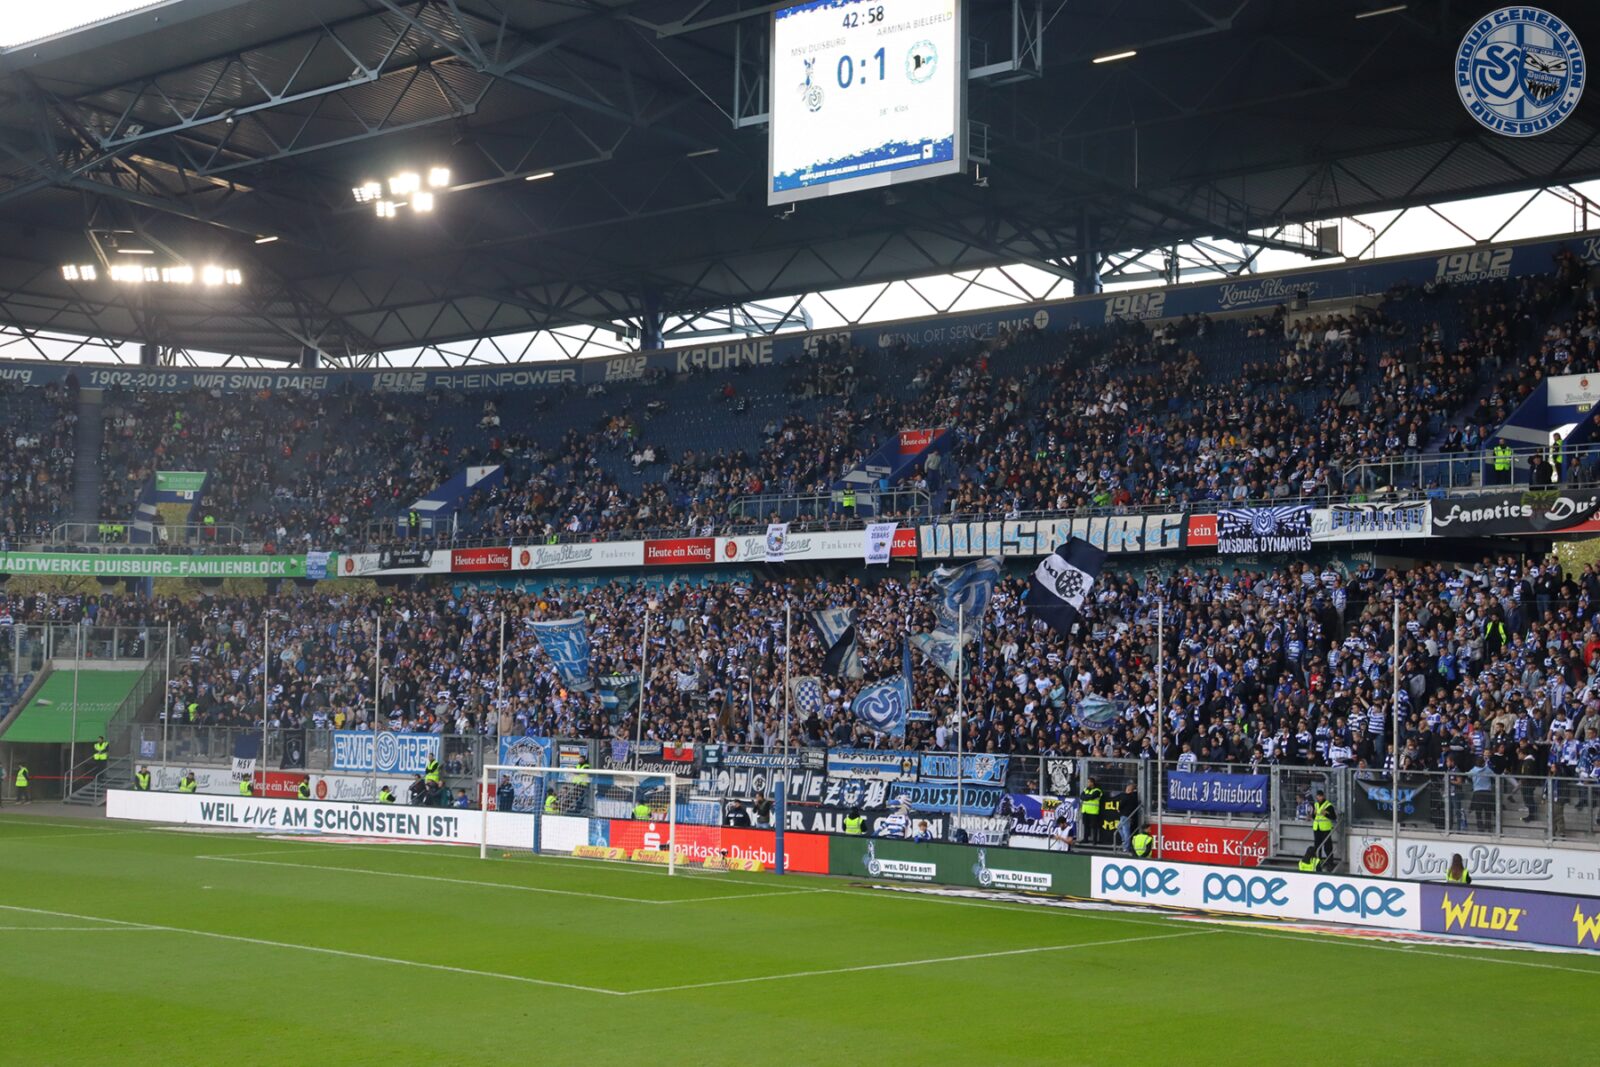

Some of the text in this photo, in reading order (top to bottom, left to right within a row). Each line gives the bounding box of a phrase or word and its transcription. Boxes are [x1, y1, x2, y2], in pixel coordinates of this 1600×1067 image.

[877, 12, 953, 36] ARMINIA BIELEFELD
[791, 37, 847, 57] MSV DUISBURG
[837, 47, 886, 89] 0:1
[1435, 248, 1514, 277] 1902
[1480, 268, 1510, 279] DABEI
[1105, 292, 1166, 316] 1902
[1218, 284, 1261, 304] König
[606, 356, 648, 375] 1902
[677, 340, 773, 372] KROHNE
[0, 368, 33, 383] urg
[90, 370, 178, 388] 1902-2013
[193, 374, 226, 389] WIR
[233, 375, 272, 389] SIND
[372, 372, 428, 390] 1902
[435, 368, 577, 389] RHEINPOWER
[536, 548, 561, 564] König
[560, 544, 593, 561] Pilsener
[648, 543, 712, 561] Heute ein König
[821, 540, 863, 551] Fankurve
[1217, 535, 1312, 554] DUISBURG DYNAMITES
[94, 558, 286, 574] DUISBURG-FAMILIENBLOCK
[455, 555, 478, 567] Heute
[478, 555, 488, 565] ein
[488, 552, 510, 569] König
[333, 734, 375, 769] EWIG
[237, 759, 251, 769] MSV
[637, 759, 692, 776] Generation
[272, 781, 282, 790] ein
[333, 779, 361, 800] König
[1170, 778, 1198, 801] Block
[1212, 782, 1264, 808] Duisburg
[201, 802, 459, 838] WEIL LIVE AM SCHÖNSTEN IST!
[578, 846, 605, 857] Sinalco
[637, 851, 665, 862] Sinalco
[670, 841, 790, 869] parkasse Duisbug
[1152, 834, 1267, 867] Heute ein König
[1469, 845, 1553, 875] Pilsener
[899, 863, 909, 872] DU
[995, 873, 1010, 881] WEIL
[1012, 873, 1023, 881] DU
[1033, 876, 1048, 884] BIST!
[1101, 863, 1181, 897] pape
[1202, 872, 1290, 908] pape
[1313, 881, 1407, 919] pape
[1441, 890, 1522, 932] WILDZ
